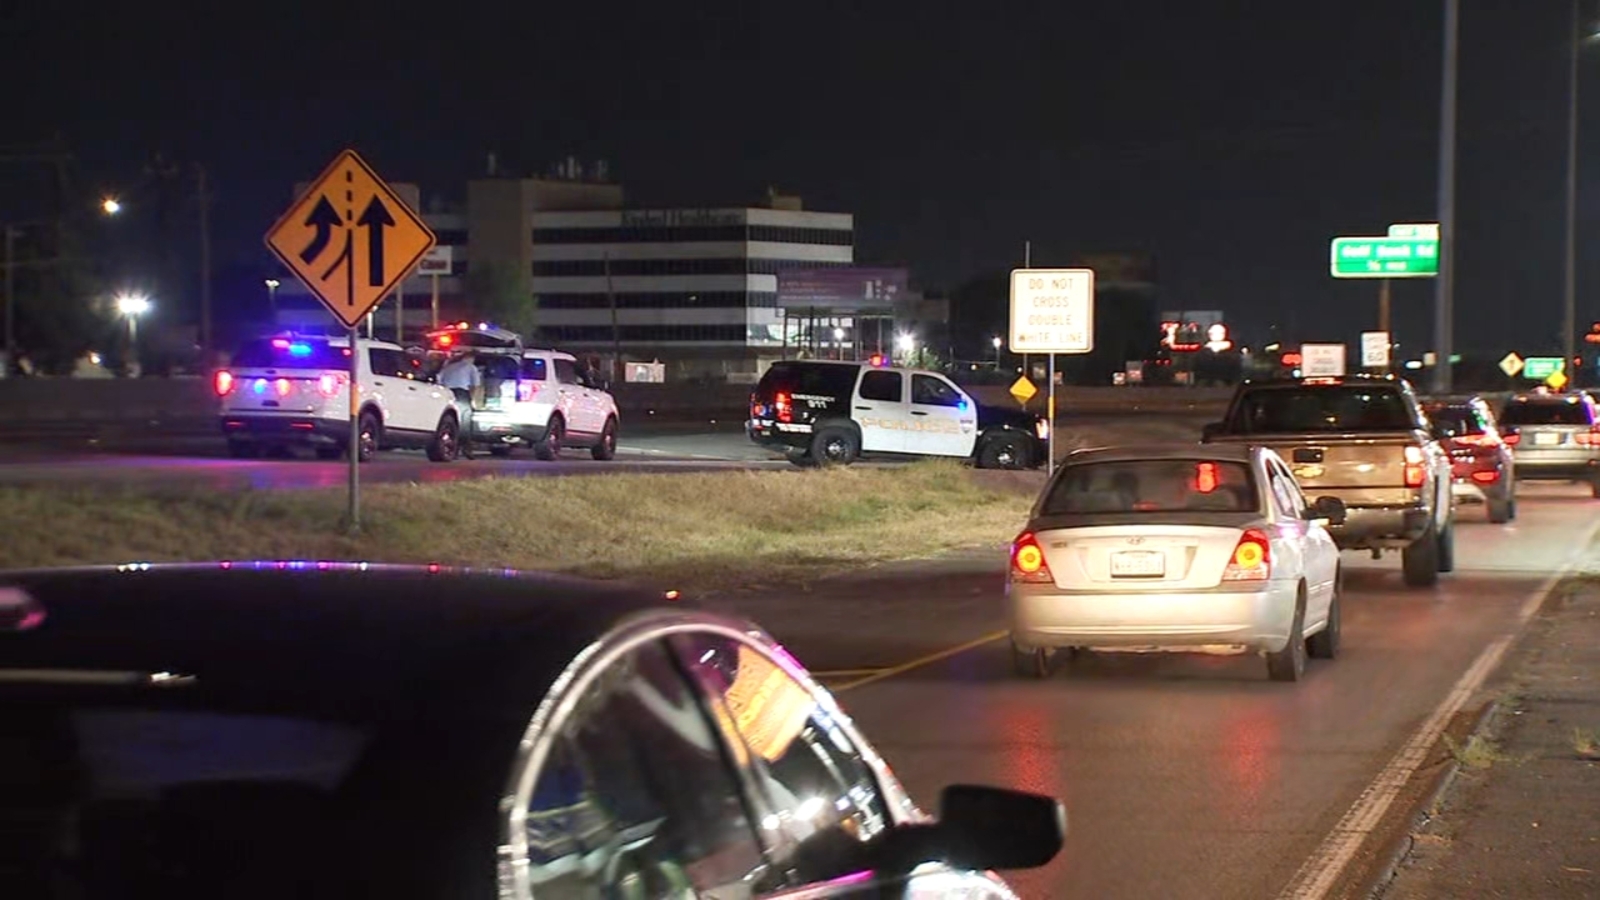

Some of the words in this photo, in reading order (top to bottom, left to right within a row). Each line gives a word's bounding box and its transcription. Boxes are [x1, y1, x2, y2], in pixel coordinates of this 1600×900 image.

[1029, 278, 1044, 290] DO
[1052, 278, 1073, 290] NOT
[1033, 296, 1069, 308] CROSS
[1028, 314, 1072, 326] DOUBLE
[1017, 332, 1051, 343] WHITE
[1059, 332, 1083, 343] LINE
